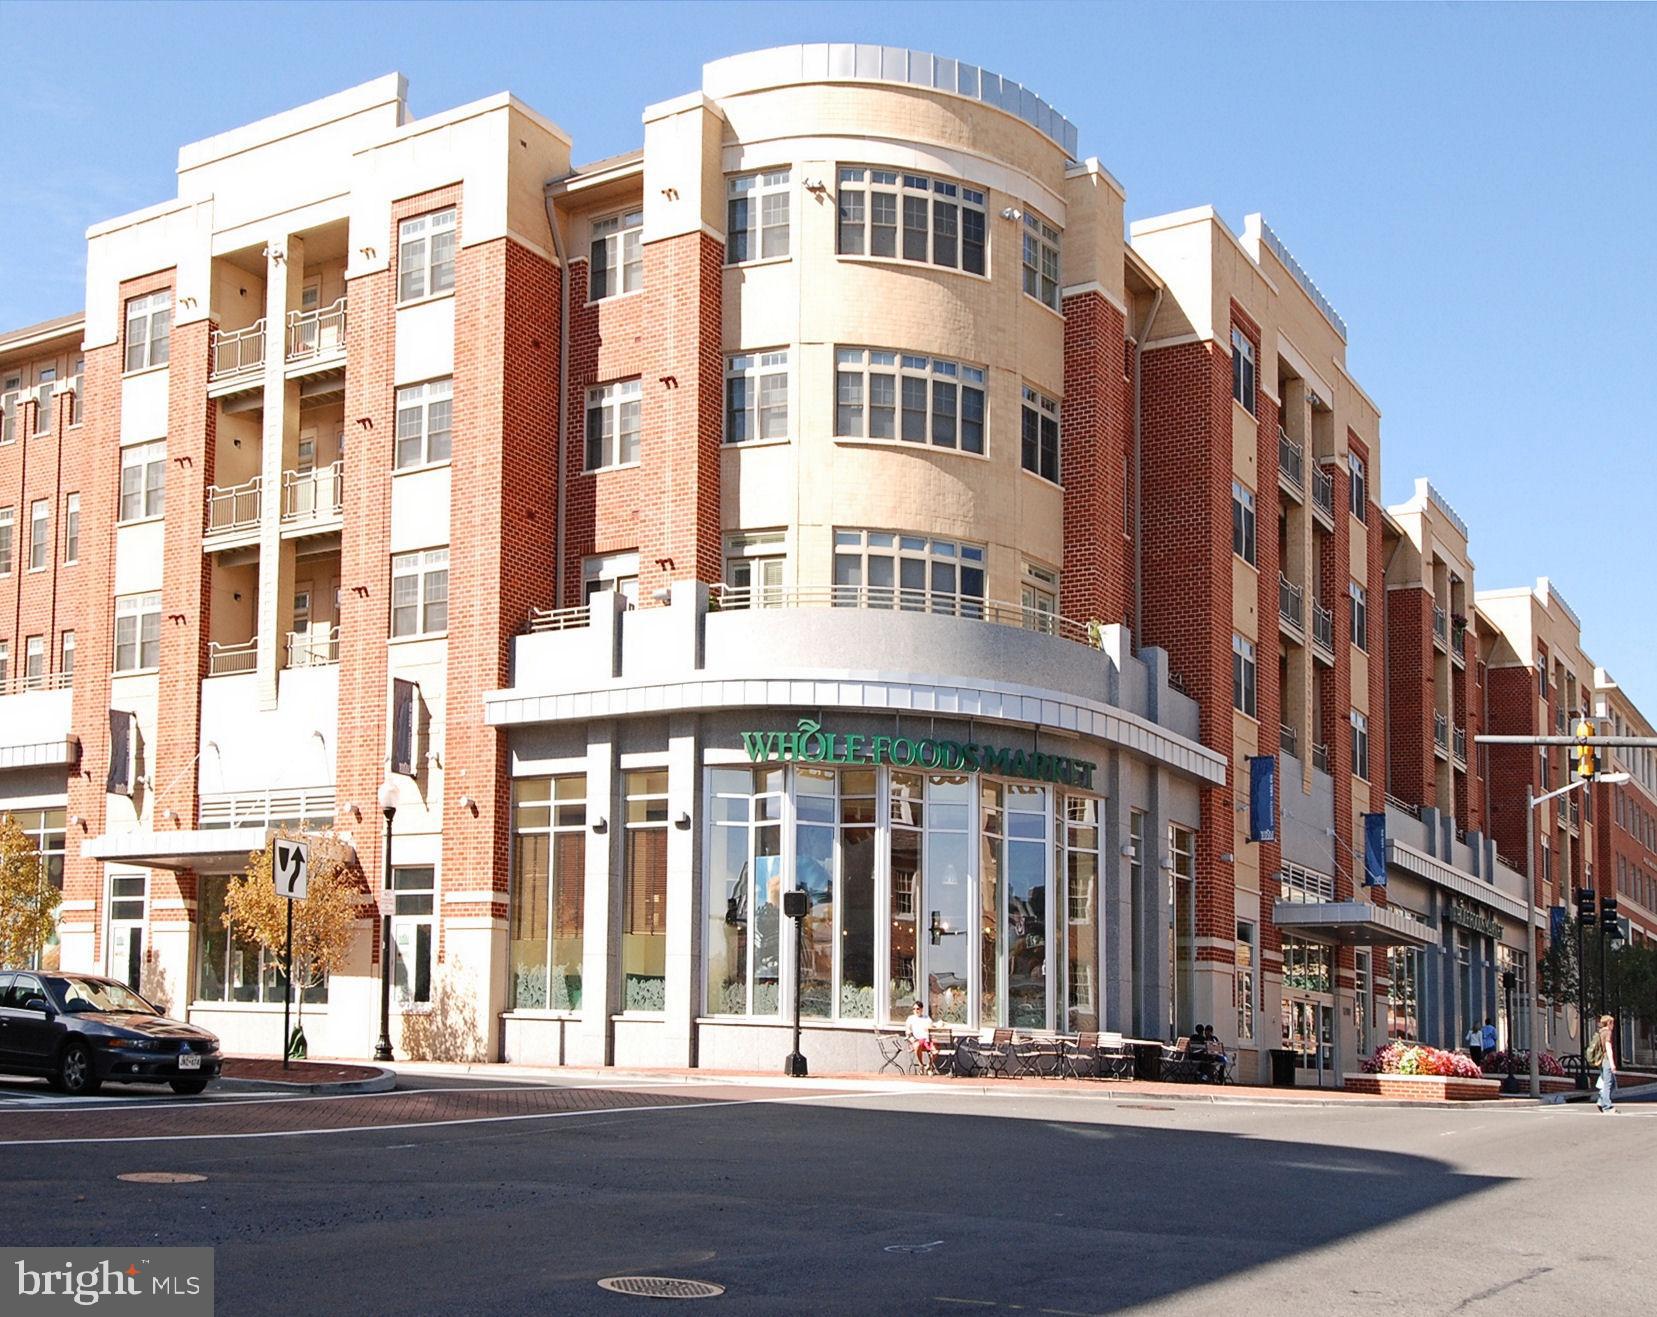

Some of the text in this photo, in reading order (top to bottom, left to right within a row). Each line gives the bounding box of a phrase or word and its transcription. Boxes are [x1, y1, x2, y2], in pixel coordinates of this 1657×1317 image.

[740, 719, 1098, 790] WHOLE FOODS MARKET
